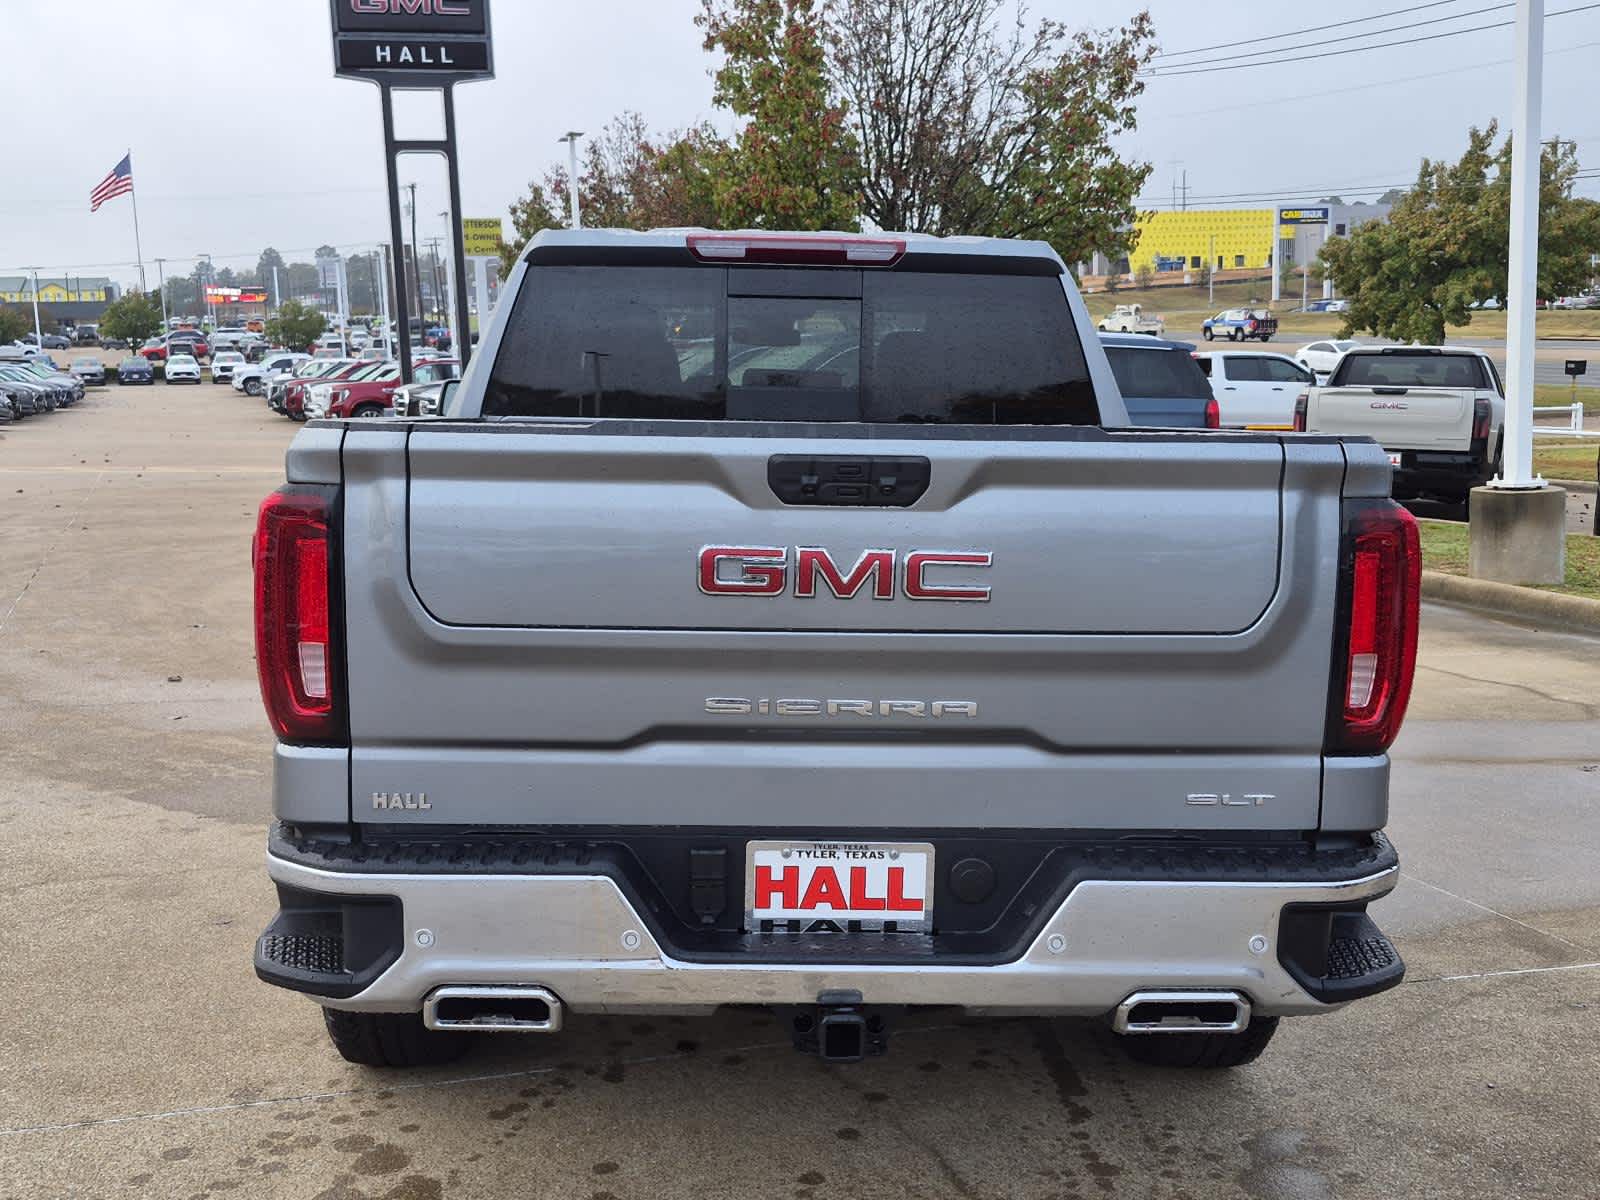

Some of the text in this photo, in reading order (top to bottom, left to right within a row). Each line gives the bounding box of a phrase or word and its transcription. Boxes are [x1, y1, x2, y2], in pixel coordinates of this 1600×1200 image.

[375, 45, 454, 63] HALL
[1370, 402, 1408, 410] GMC
[698, 544, 993, 602] GMC
[704, 697, 978, 718] SIERRA
[372, 792, 433, 810] HALL
[1186, 793, 1276, 807] SLT
[797, 851, 885, 860] TYLER, TEXAS
[755, 865, 923, 911] HALL
